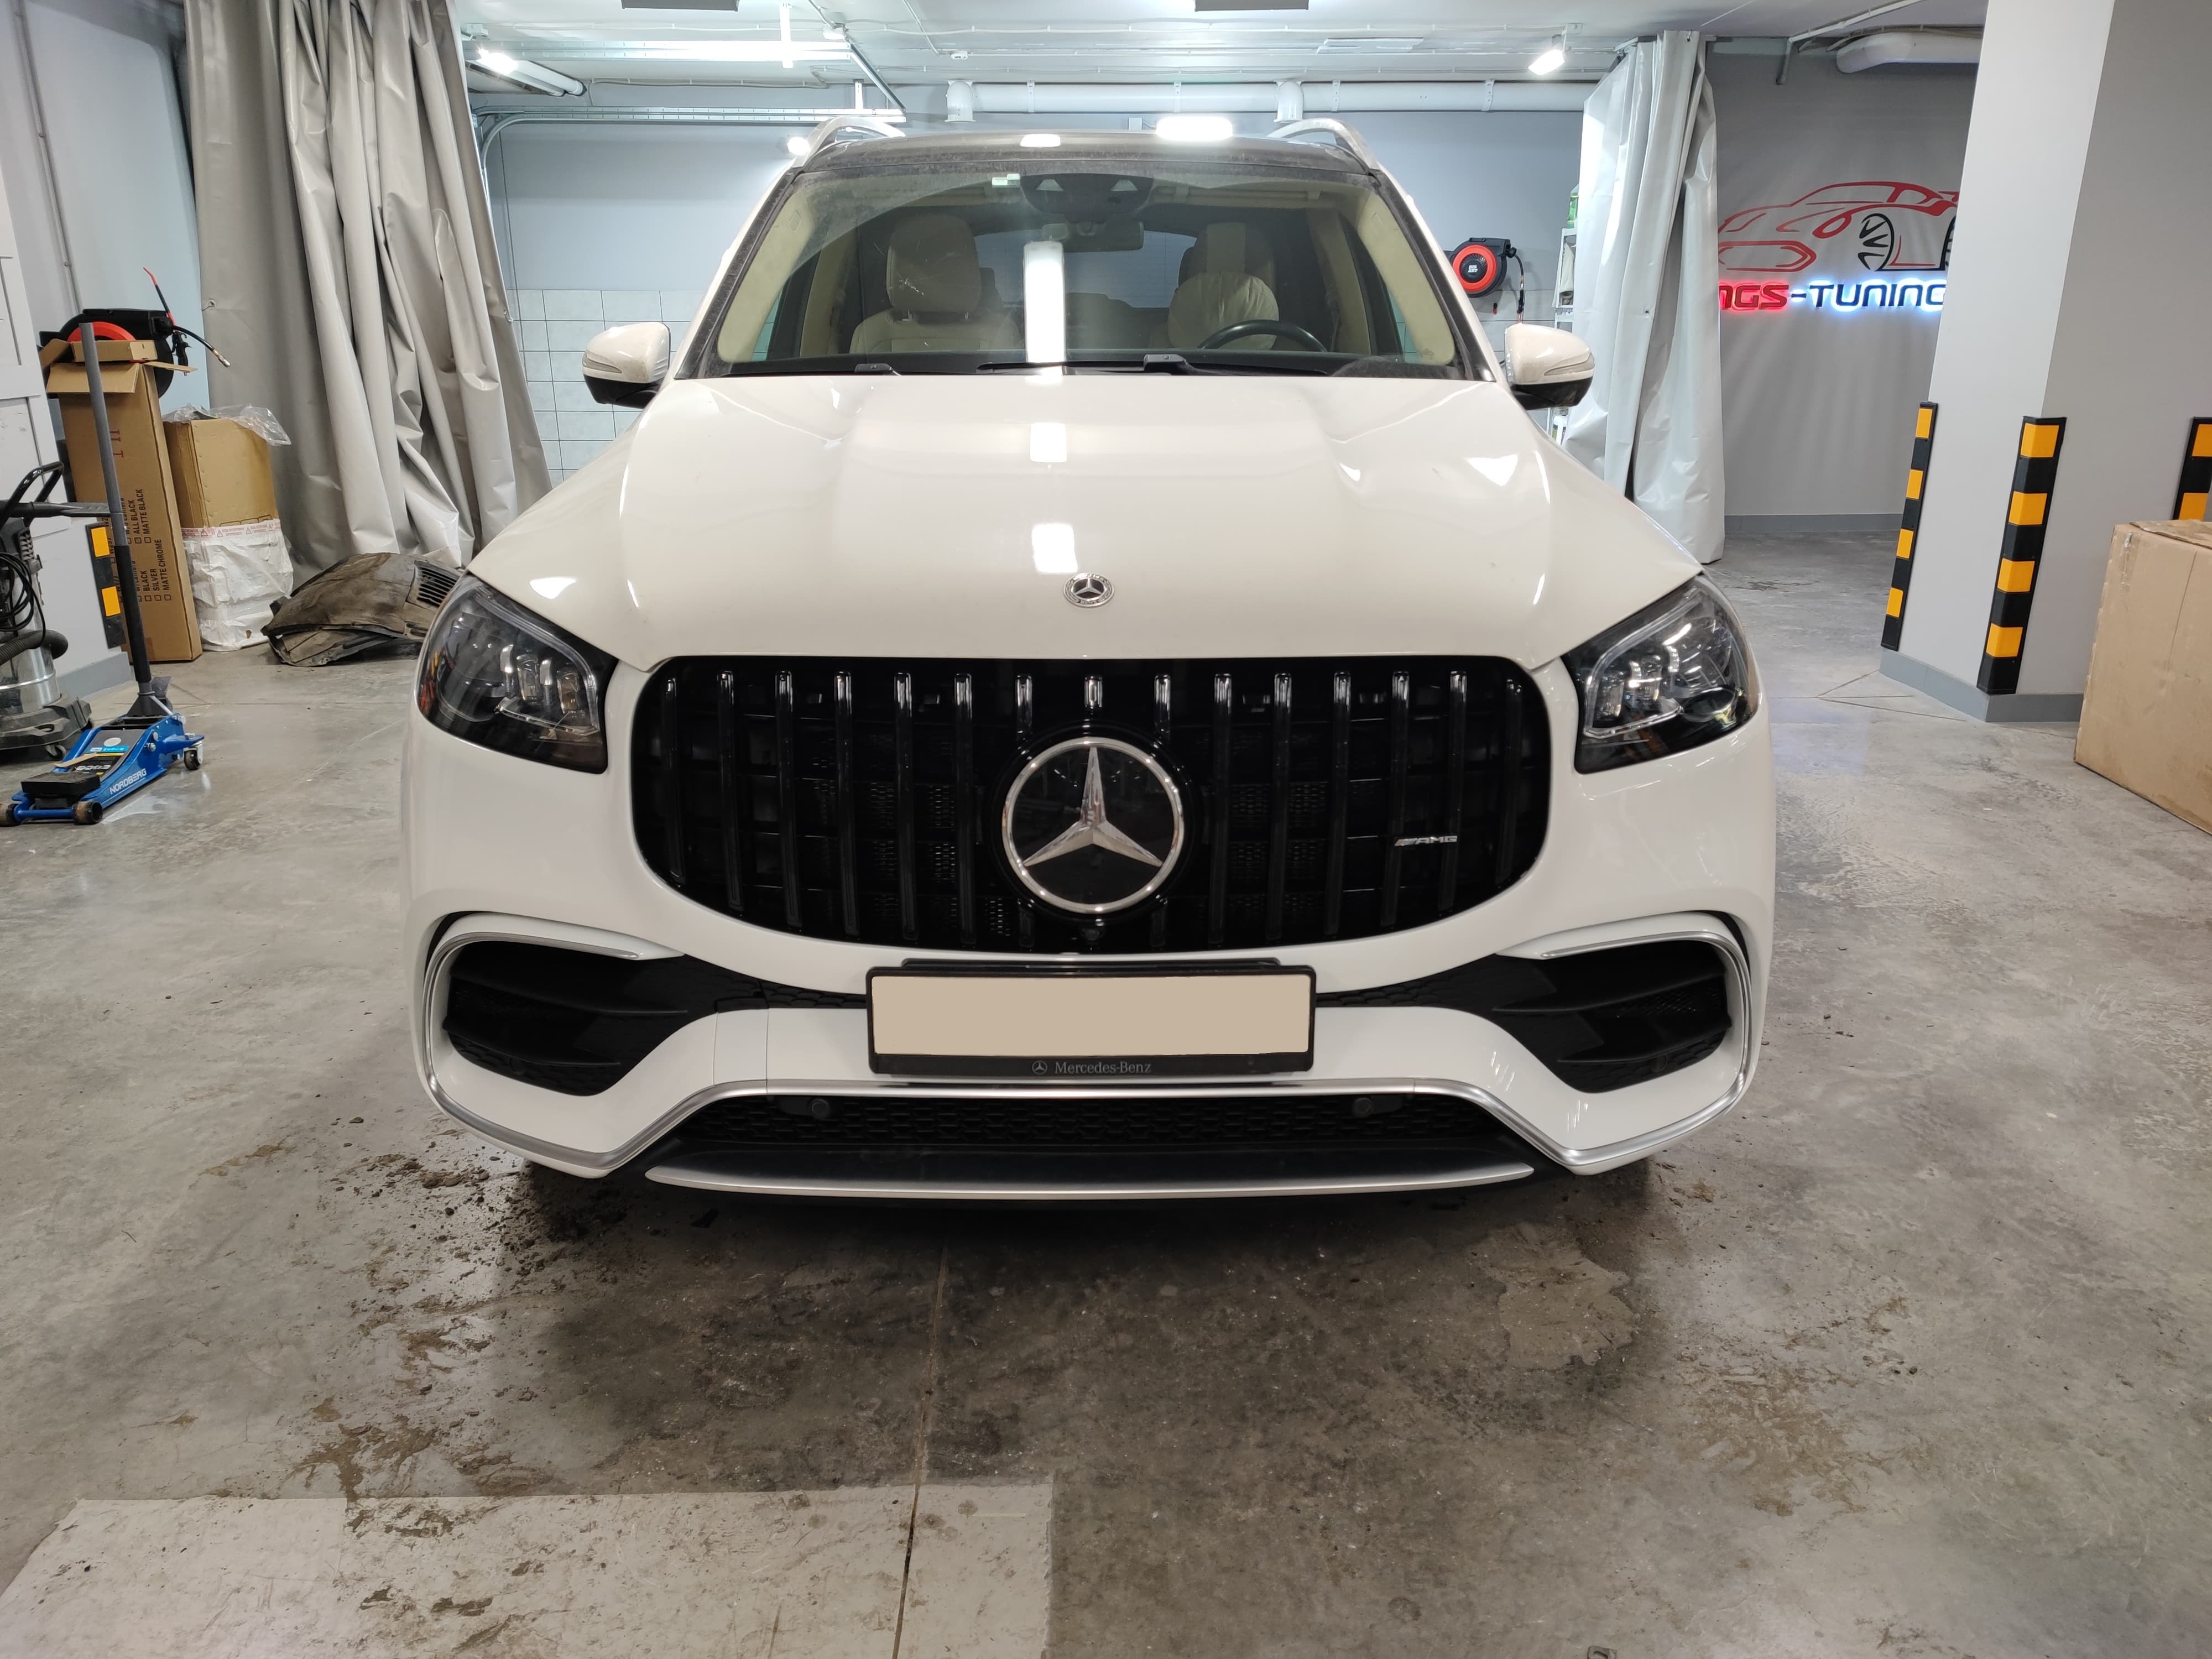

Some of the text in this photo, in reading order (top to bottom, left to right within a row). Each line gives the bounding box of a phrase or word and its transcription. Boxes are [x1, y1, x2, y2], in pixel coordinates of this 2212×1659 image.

[128, 499, 138, 521] BLACK
[135, 489, 151, 534] MATTE BLACK
[154, 539, 170, 591] MATTE CHROME
[140, 570, 150, 591] BLACK
[150, 568, 160, 591] SILVER
[109, 768, 147, 795] NORDBERG
[1055, 1061, 1152, 1074] Mercedes-Benz
